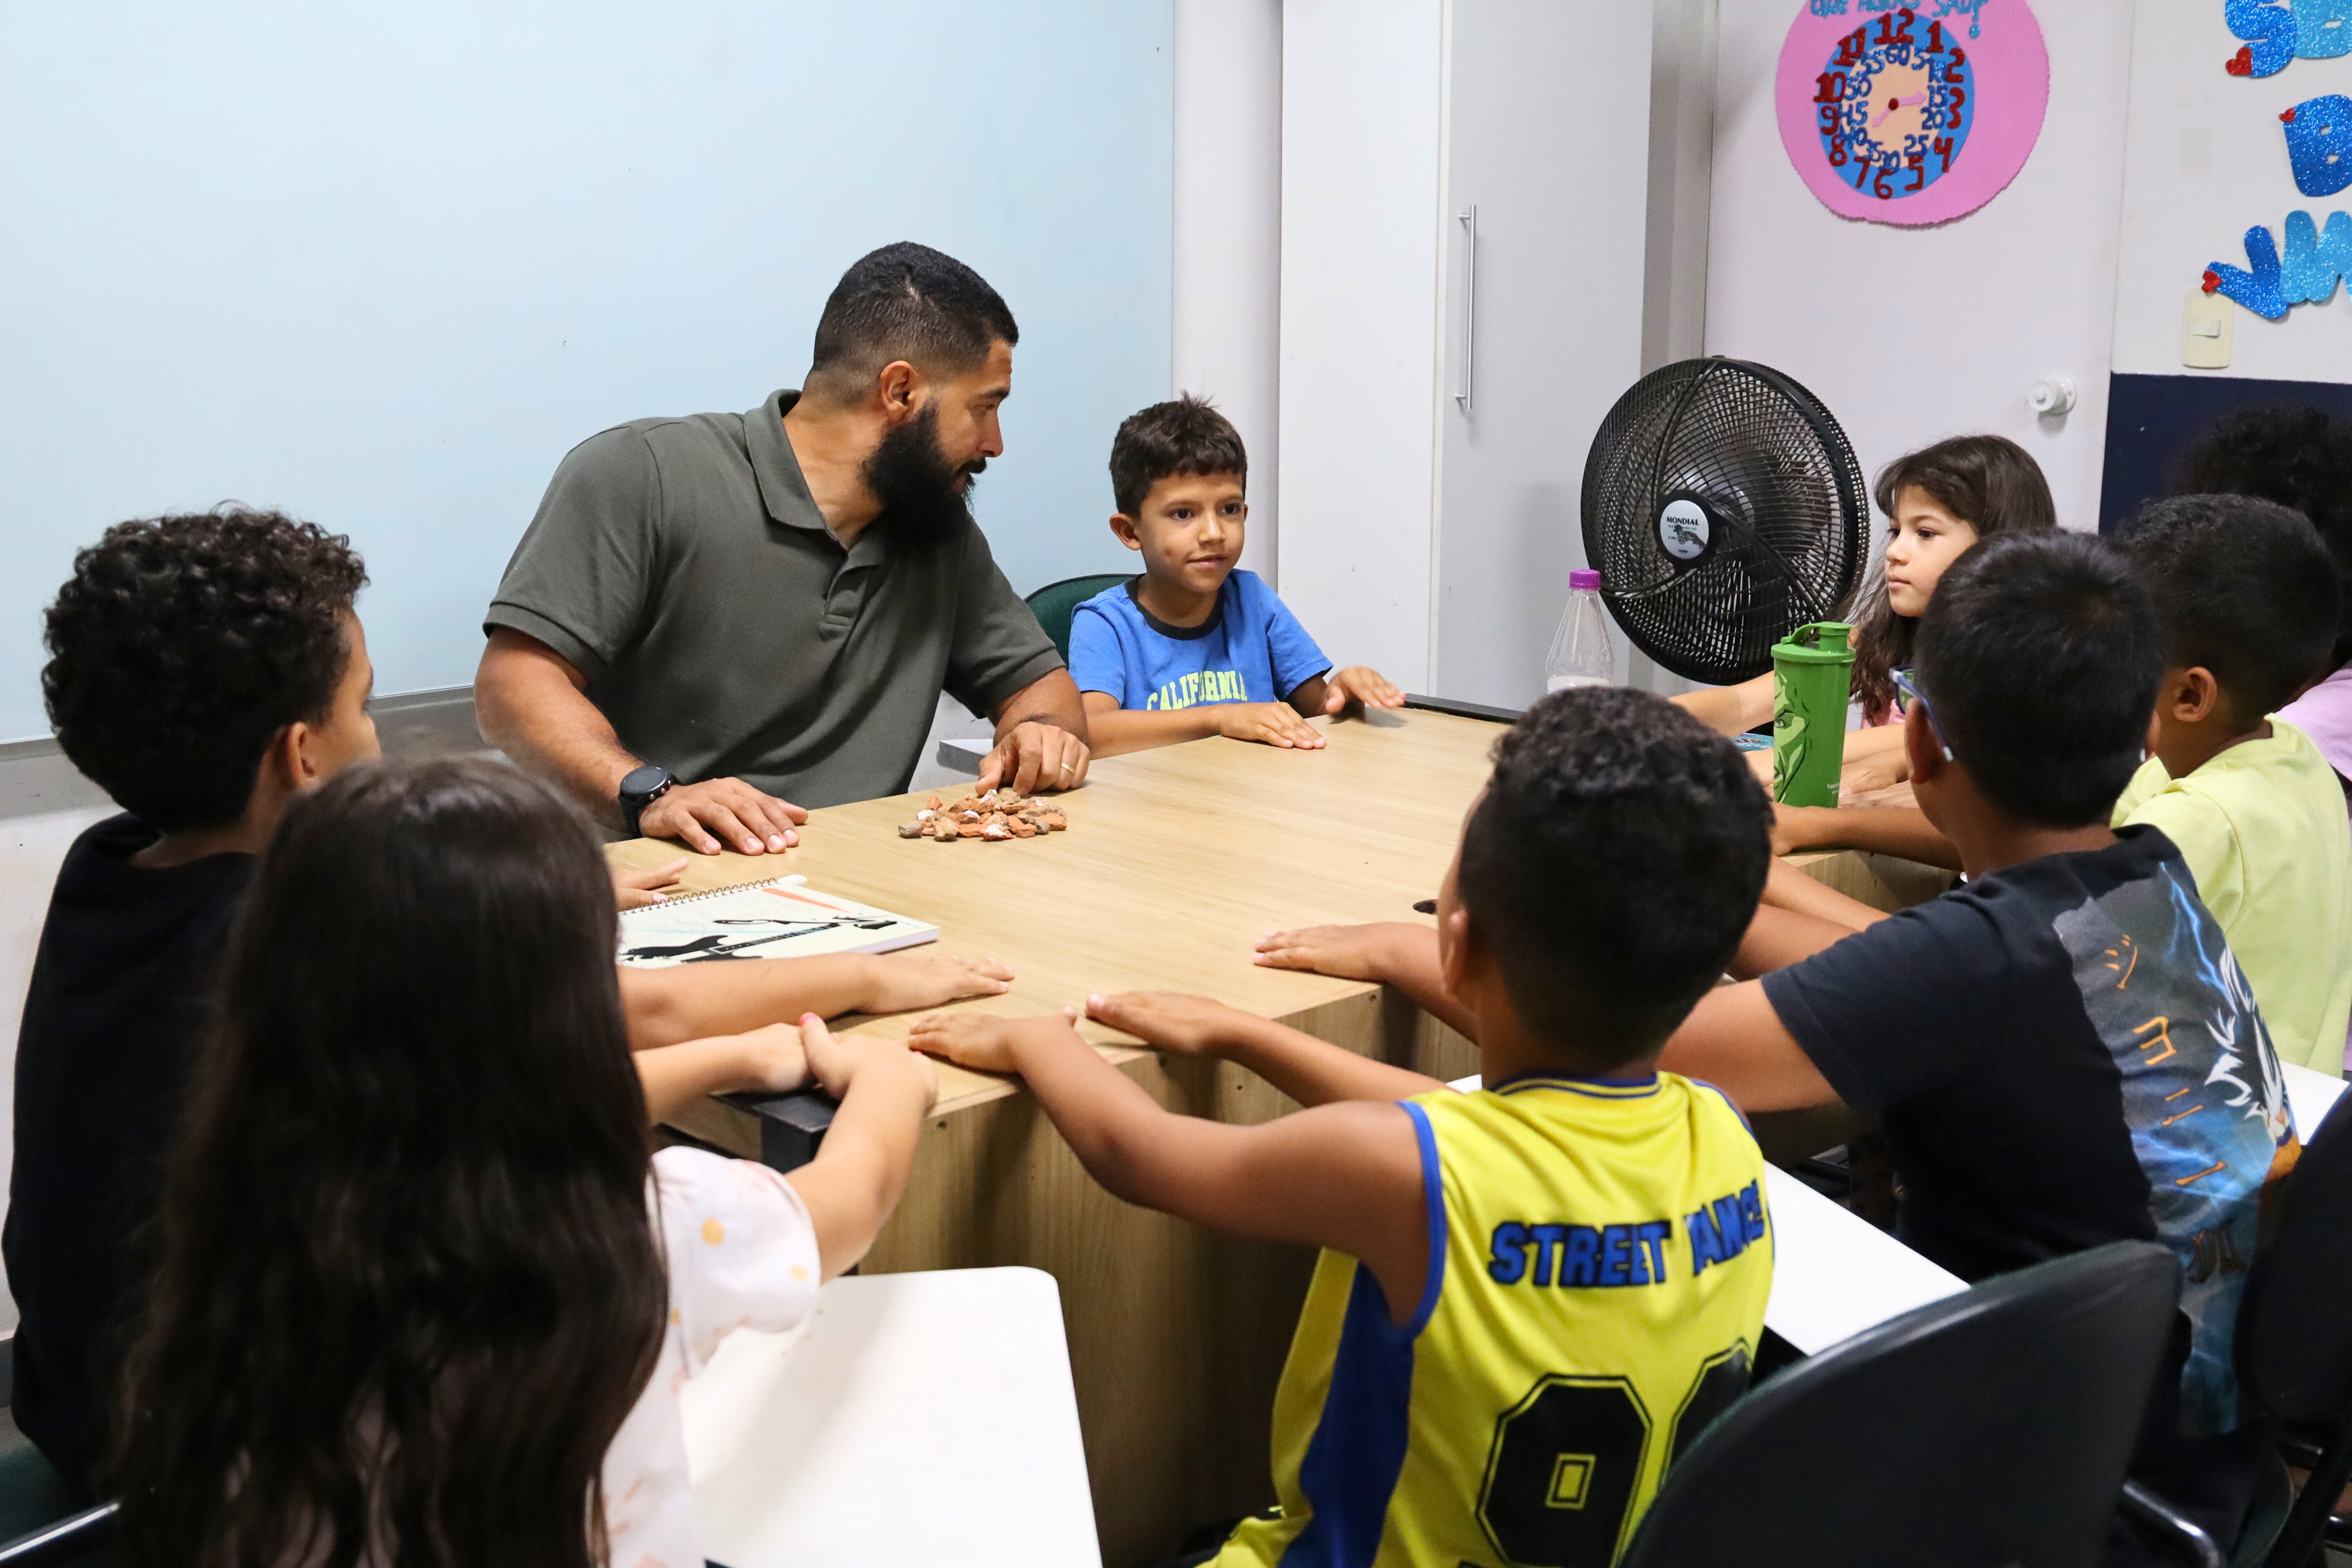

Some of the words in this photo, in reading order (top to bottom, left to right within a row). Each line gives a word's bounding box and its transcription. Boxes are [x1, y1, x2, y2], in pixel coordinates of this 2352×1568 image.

[1874, 7, 1915, 44] 12
[1927, 20, 1944, 53] 1
[1833, 27, 1866, 66] 11
[1885, 42, 1911, 66] 60
[1945, 47, 1965, 83] 2
[1813, 71, 1846, 103] 10
[1844, 74, 1872, 100] 50
[1927, 85, 1948, 108] 15
[1820, 105, 1839, 136] 9
[1837, 101, 1868, 126] 45
[1920, 107, 1945, 130] 20
[1947, 86, 1965, 129] 3
[1829, 133, 1848, 166] 8
[1904, 134, 1929, 157] 25
[1934, 136, 1954, 172] 4
[1854, 155, 1871, 188] 7
[1874, 168, 1894, 200] 6
[1904, 155, 1924, 191] 5
[1667, 516, 1699, 526] MONDIAL
[1488, 1219, 1671, 1288] STREET
